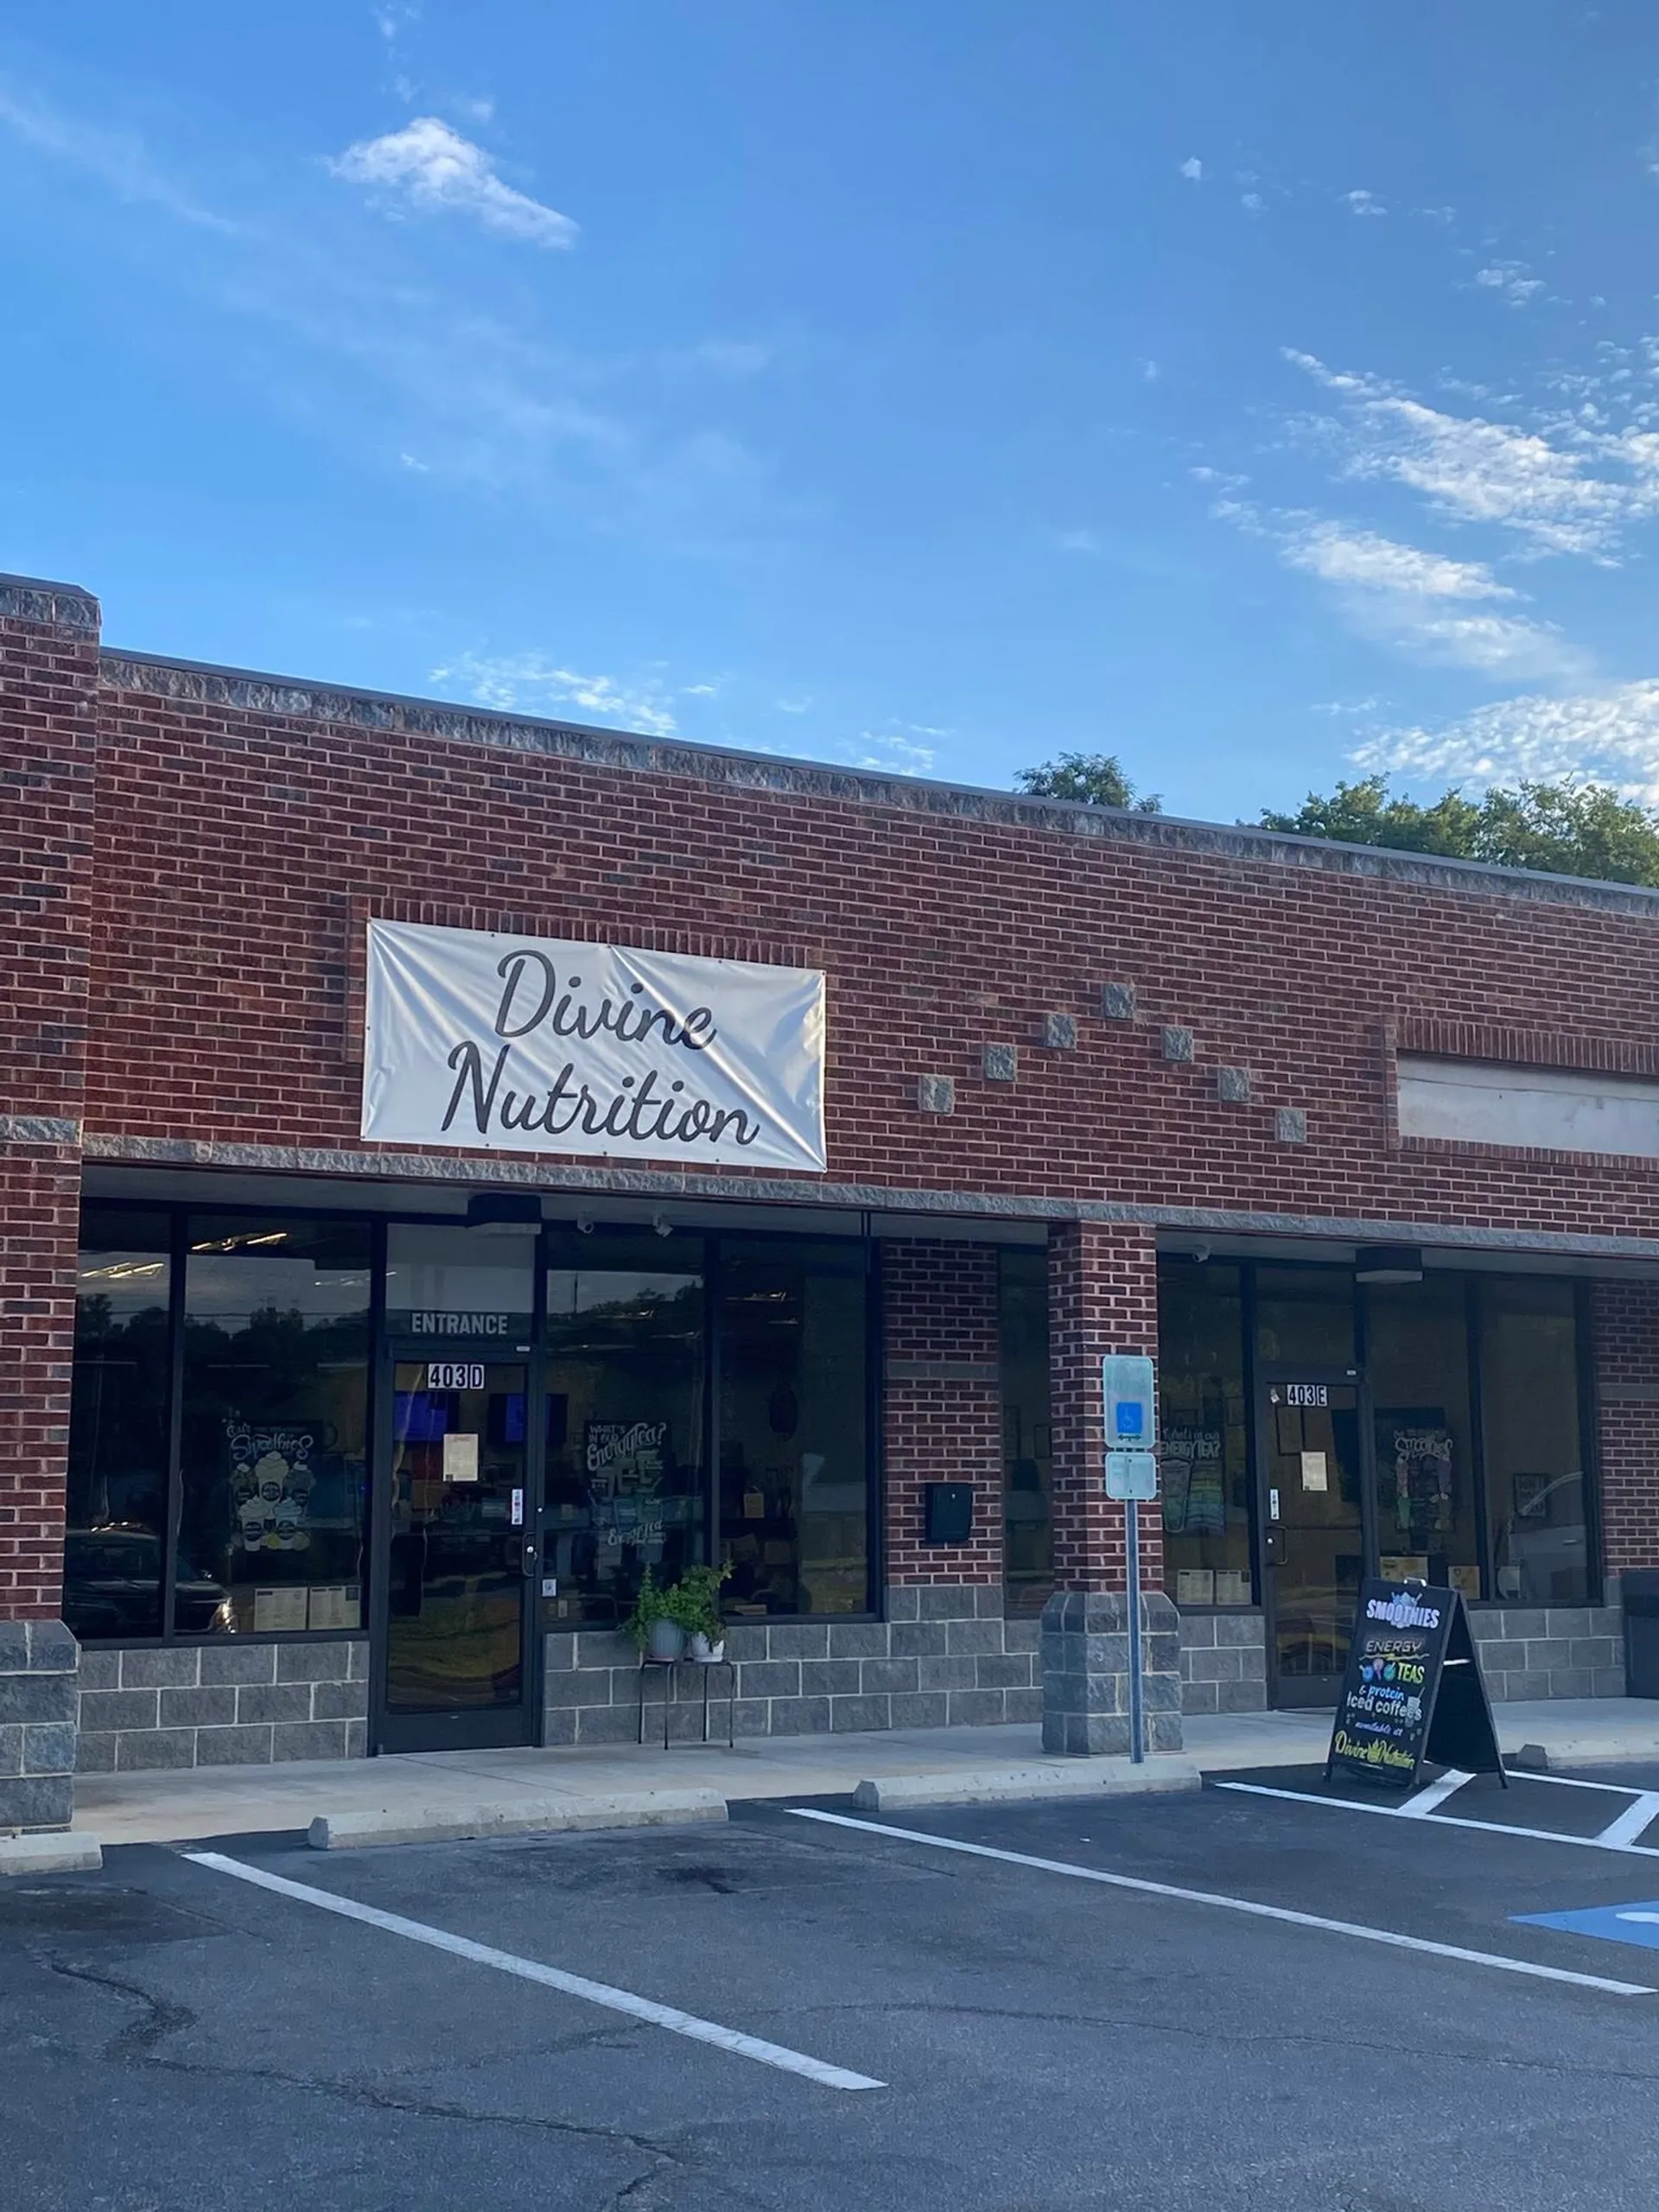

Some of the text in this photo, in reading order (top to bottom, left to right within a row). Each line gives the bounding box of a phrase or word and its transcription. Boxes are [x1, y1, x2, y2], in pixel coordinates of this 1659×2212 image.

[494, 949, 718, 1051] Divine
[440, 1039, 761, 1146] Nutrition
[411, 1313, 509, 1335] ENTRANCE
[1366, 1599, 1440, 1629] SMOOTHIES
[1365, 1640, 1422, 1653] ENERGY
[1397, 1662, 1425, 1684] TEAS
[1367, 1685, 1405, 1701] protein
[1375, 1699, 1423, 1721] coffees
[1334, 1730, 1368, 1759] Divine
